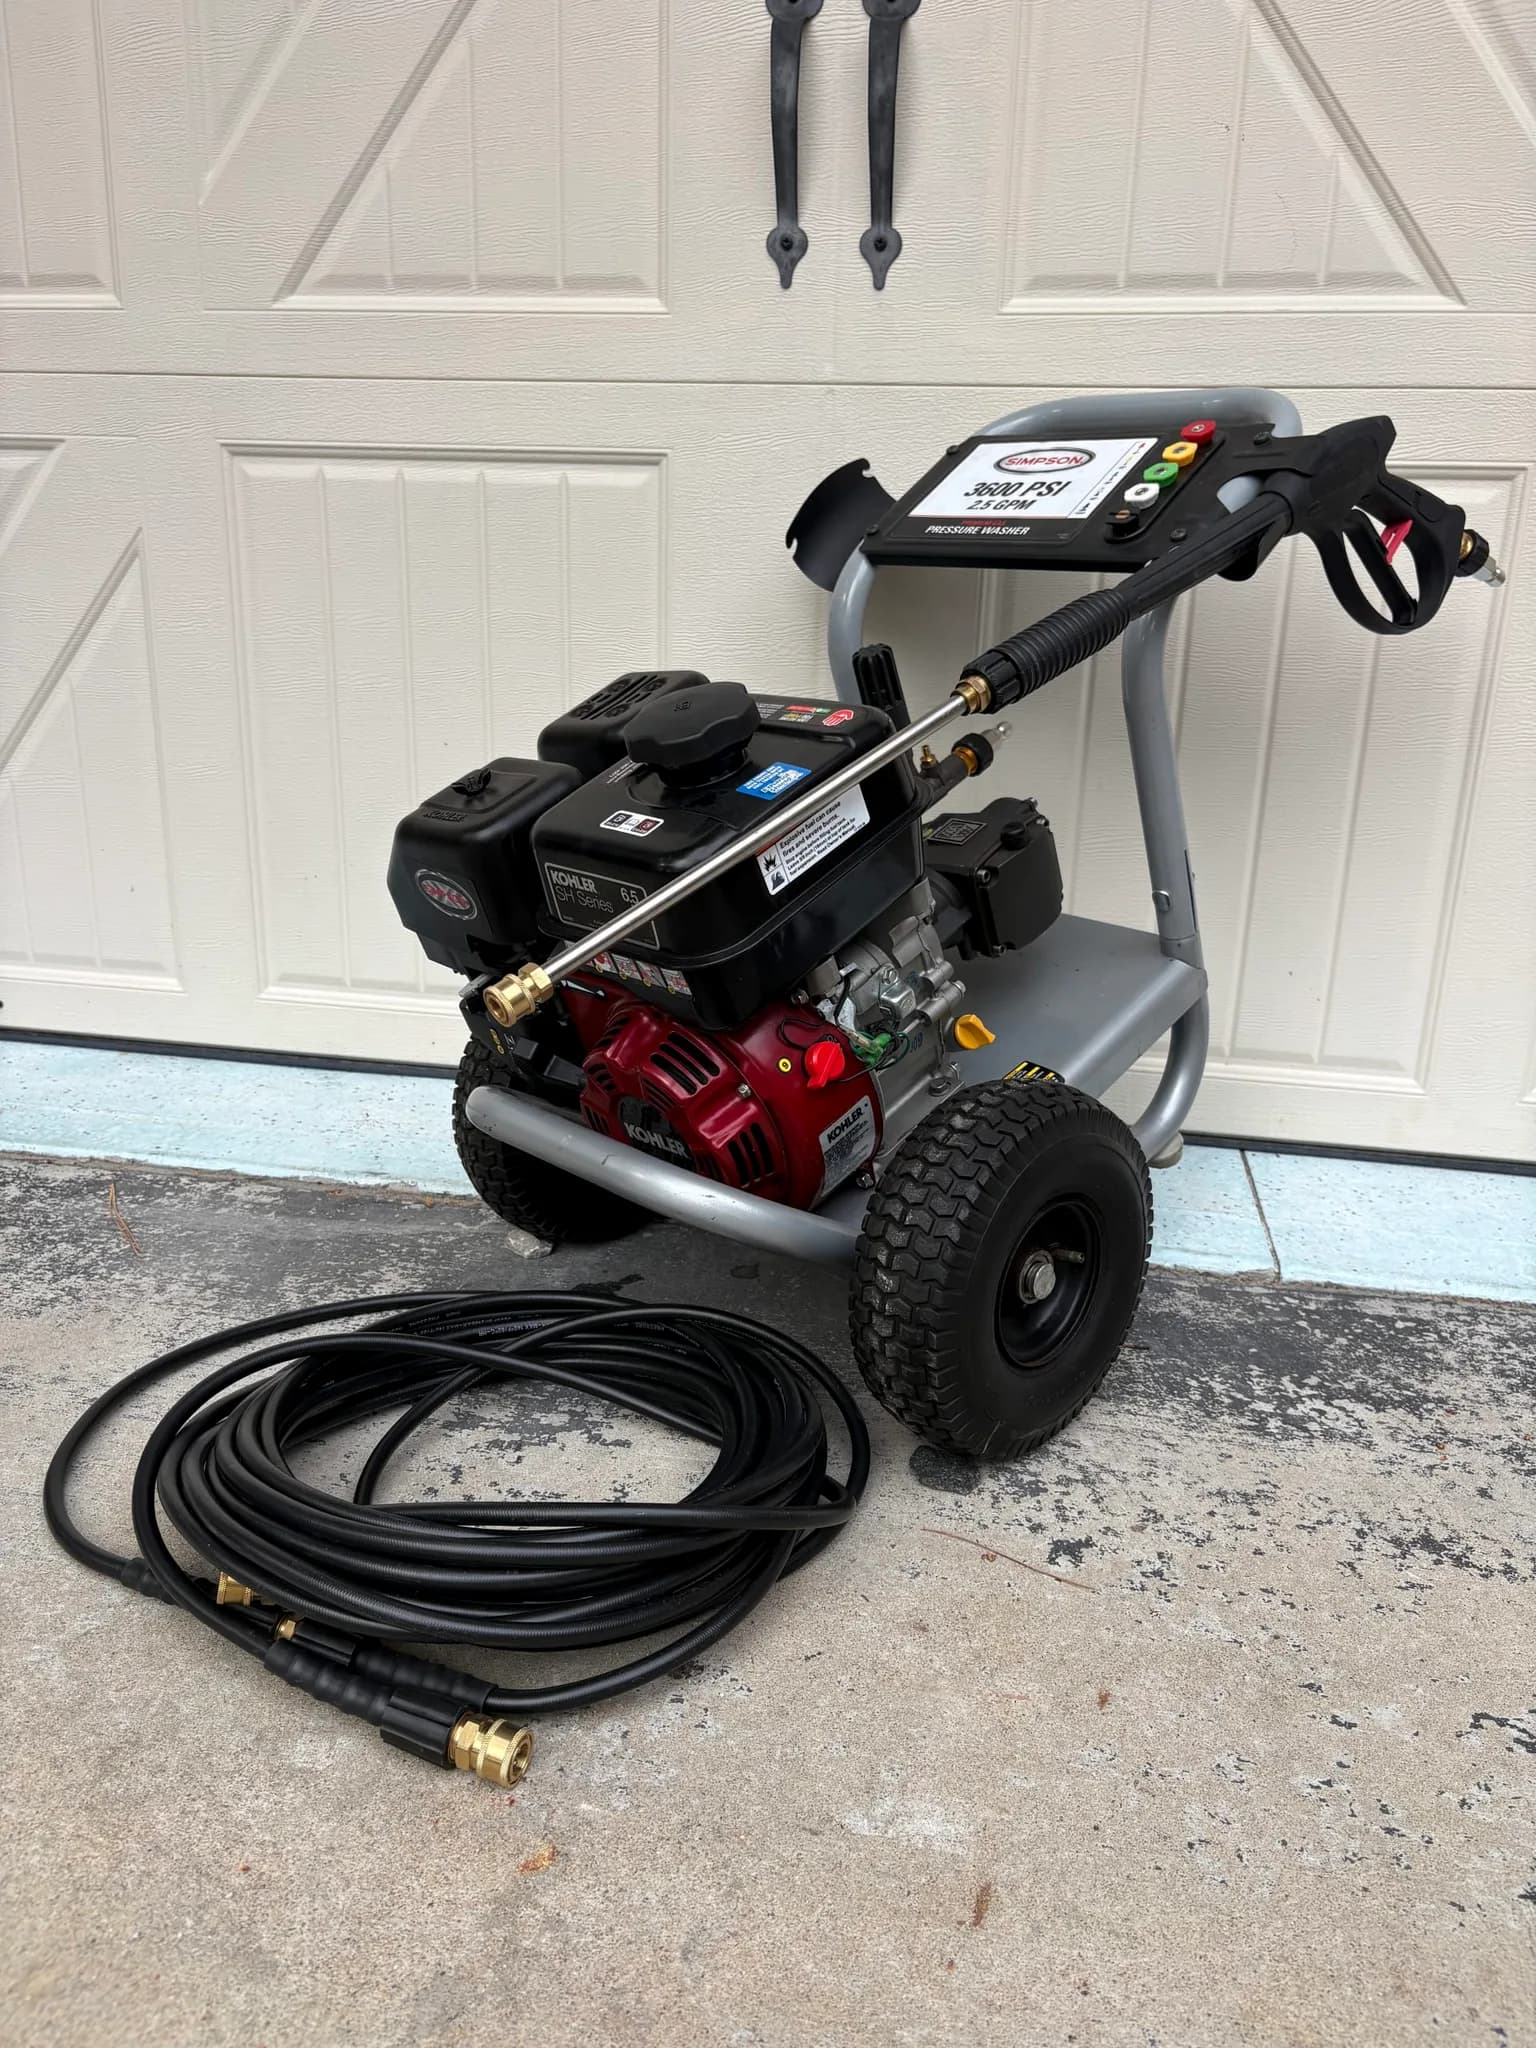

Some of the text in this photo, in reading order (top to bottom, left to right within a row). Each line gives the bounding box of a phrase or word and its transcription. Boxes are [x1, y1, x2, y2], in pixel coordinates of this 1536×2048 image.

[1004, 455, 1084, 466] SIMPSON
[963, 480, 1072, 497] 3600 PSI
[993, 499, 1037, 510] GPM
[924, 525, 1031, 536] PRESSURE WASHER
[804, 818, 816, 831] fuel
[815, 812, 827, 823] can
[782, 845, 796, 857] fires
[795, 837, 806, 849] and
[550, 869, 598, 894] KOHLER
[555, 885, 614, 913] SH Series
[827, 1106, 864, 1143] KOHLER
[624, 1122, 691, 1158] KOHLER
